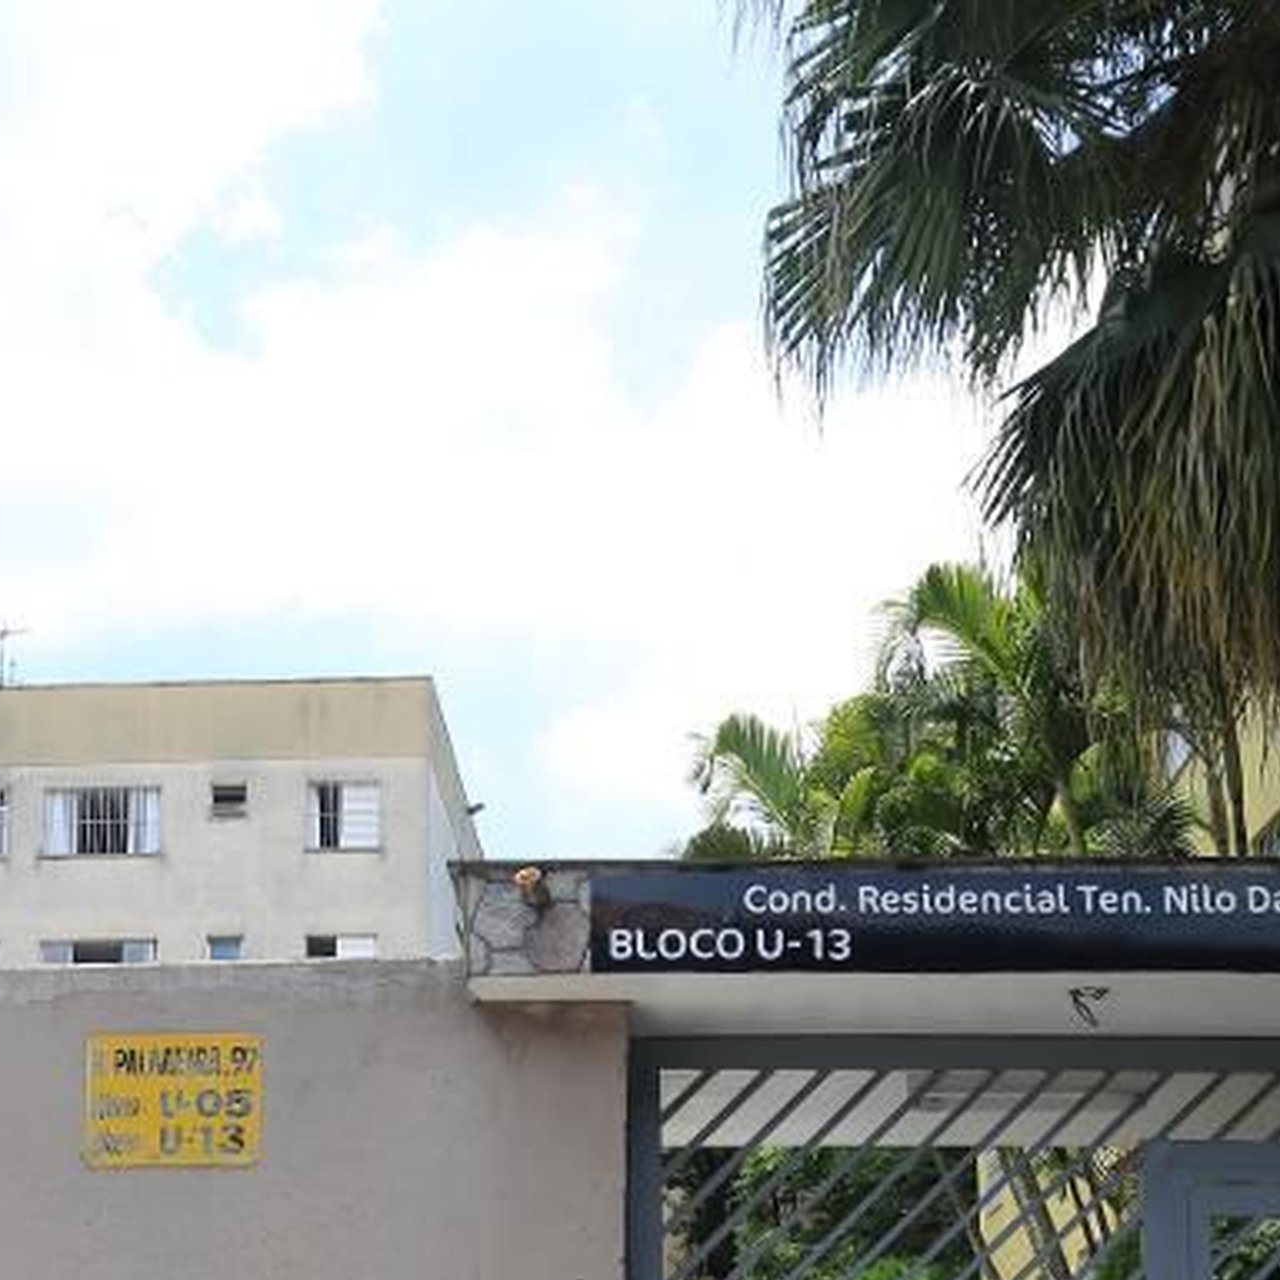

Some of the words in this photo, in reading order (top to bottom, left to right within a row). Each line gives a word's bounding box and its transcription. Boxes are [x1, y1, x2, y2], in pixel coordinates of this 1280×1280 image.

[742, 883, 847, 914] Cond.
[858, 883, 1069, 914] Residencial
[1076, 884, 1151, 914] Ten.
[1163, 883, 1237, 914] Nilo
[610, 927, 745, 961] BLOCO
[756, 928, 852, 961] U-13
